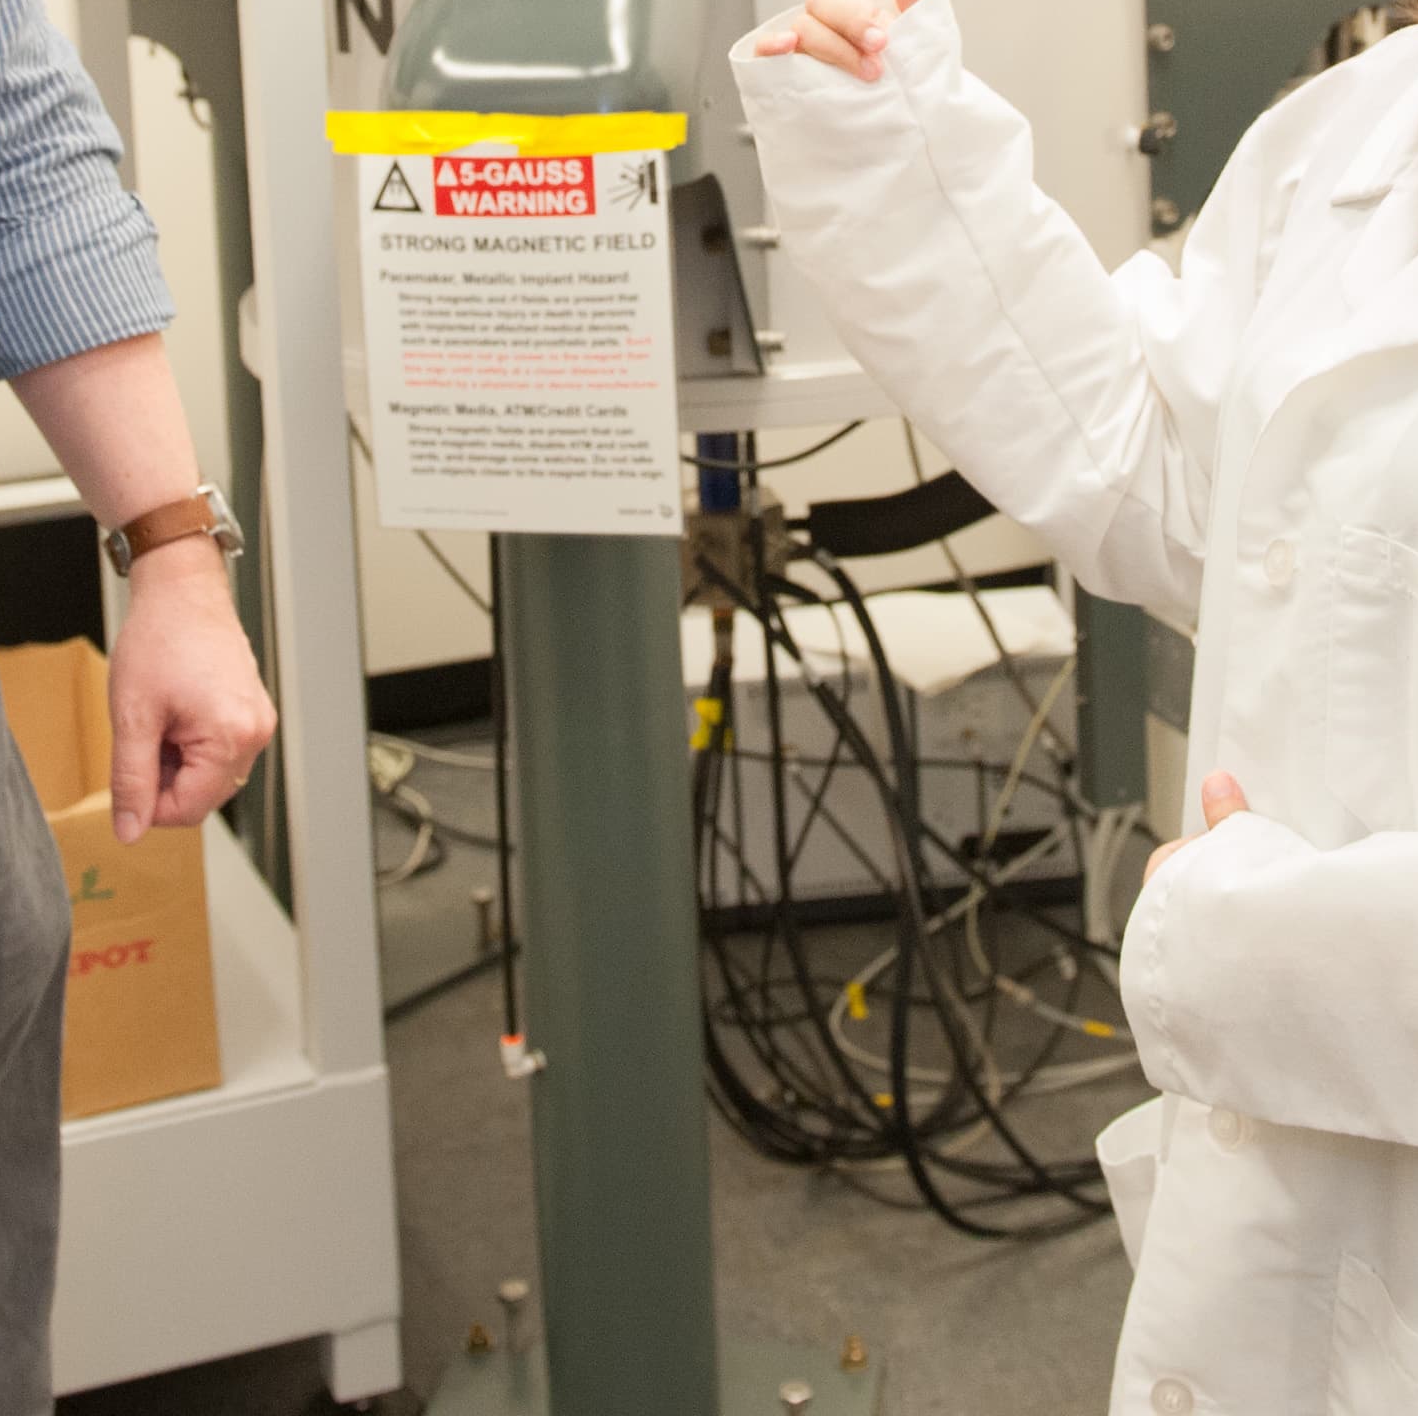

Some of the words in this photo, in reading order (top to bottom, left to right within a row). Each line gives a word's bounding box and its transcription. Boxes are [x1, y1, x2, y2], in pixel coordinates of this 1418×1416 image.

[458, 160, 584, 186] 5-GAUSS
[450, 190, 588, 215] WARNING
[381, 234, 466, 253] STRONG
[474, 234, 585, 253] MAGNETIC
[593, 232, 656, 250] FIELD
